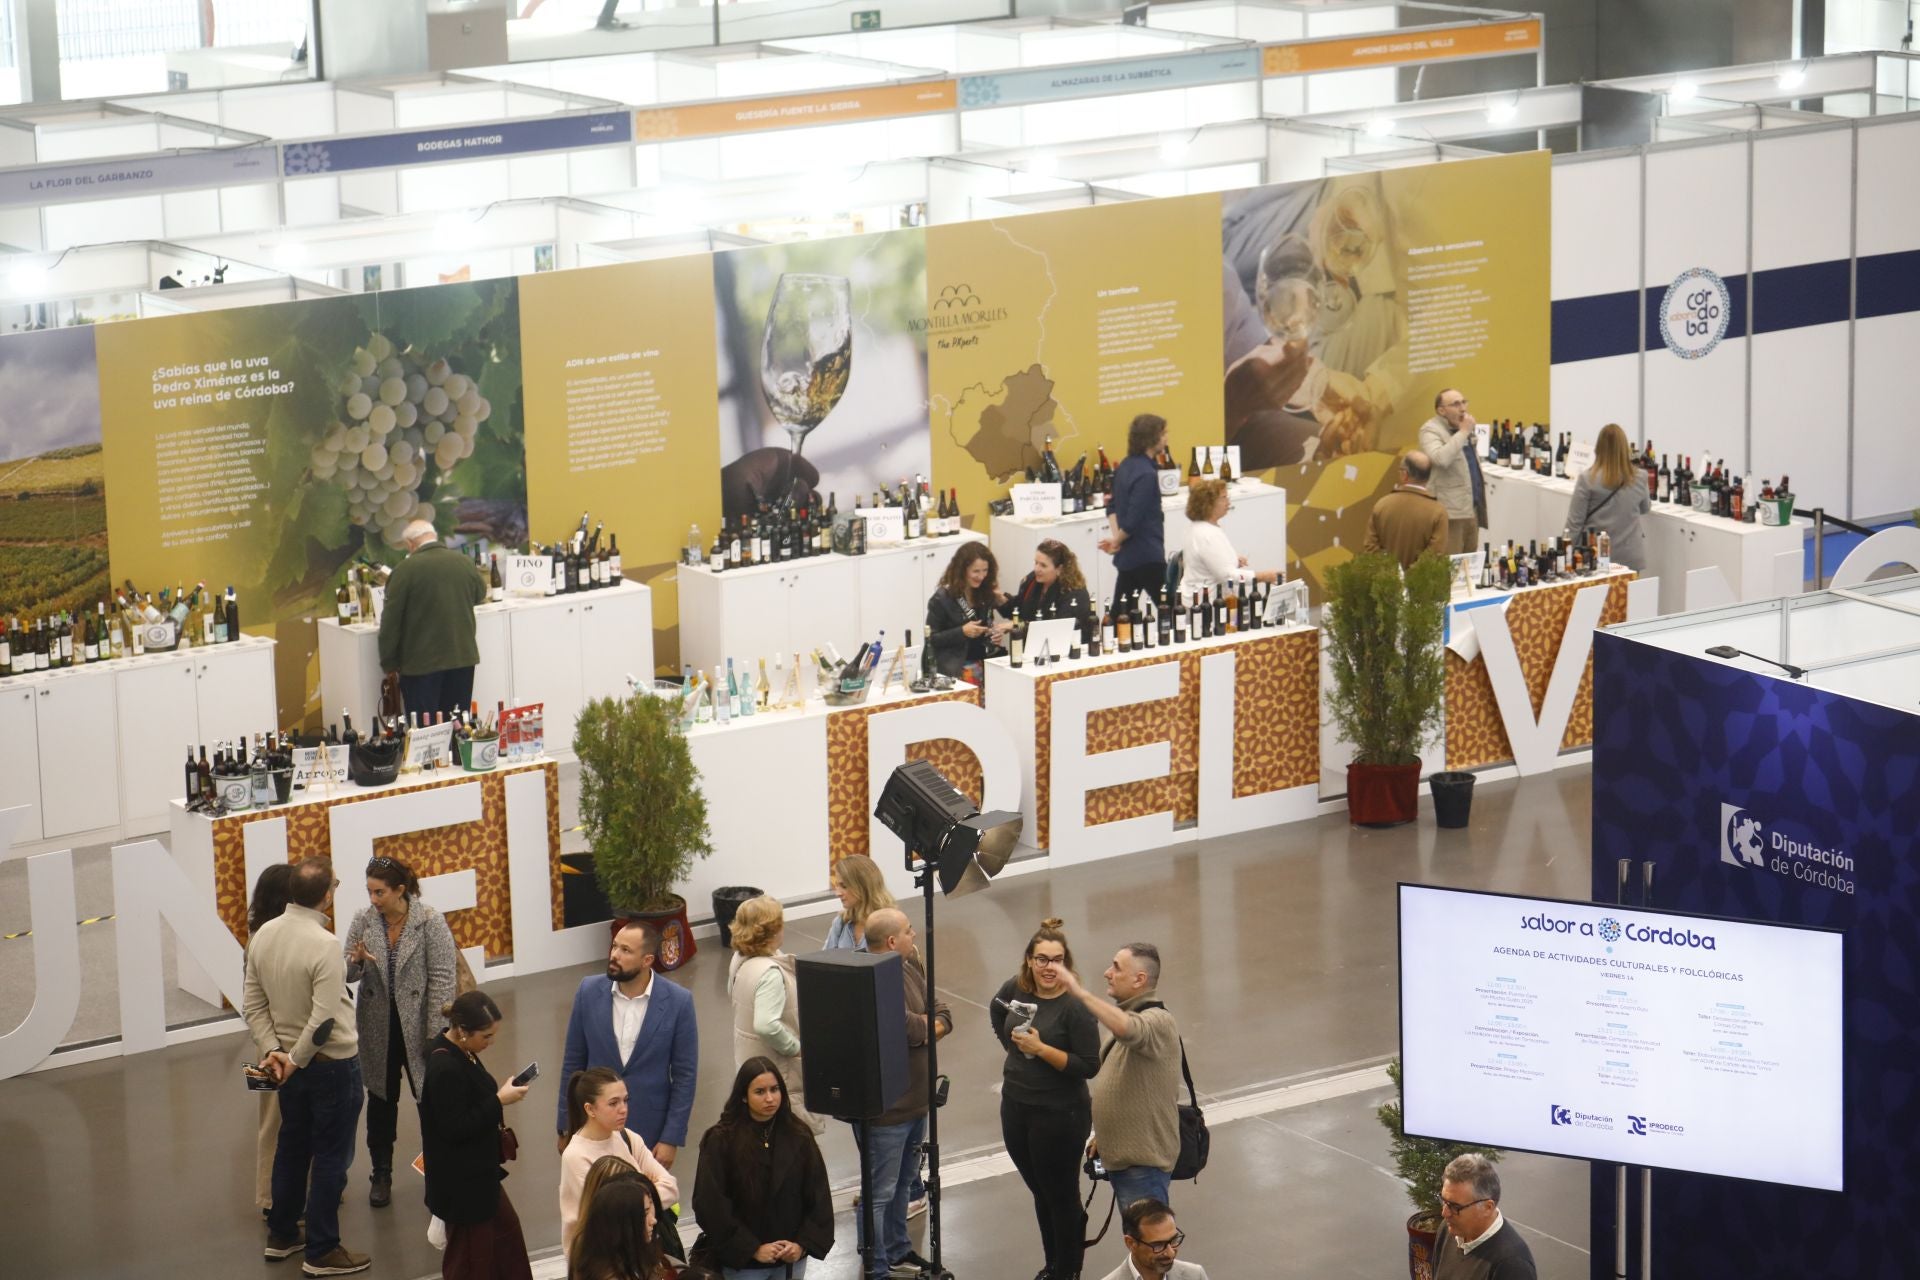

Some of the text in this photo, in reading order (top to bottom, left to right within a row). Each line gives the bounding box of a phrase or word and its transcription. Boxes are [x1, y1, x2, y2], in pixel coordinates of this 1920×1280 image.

[1414, 42, 1427, 50] DEL
[1051, 68, 1171, 88] ALMAZARAS DE LA SUBBÉTICA
[780, 105, 812, 116] FUENTE
[815, 104, 827, 113] LA
[830, 101, 860, 112] SIERRA
[417, 135, 502, 152] BODEGAS HATHOR
[30, 170, 154, 190] LA FLOR DEL GARBANZO
[907, 314, 959, 332] MONTILLA
[938, 339, 949, 349] the
[152, 356, 268, 381] ¿Sabías que la uva
[566, 359, 583, 367] ADN
[608, 353, 629, 362] estilo
[153, 369, 280, 394] Pedro Ximénez es la
[153, 381, 294, 409] uva reina de Córdoba?
[516, 558, 542, 569] FINO
[296, 768, 345, 780] Arrope
[868, 650, 1318, 893] DEL
[1772, 832, 1854, 871] Diputación
[1771, 856, 1854, 894] de Córdoba
[1521, 914, 1576, 933] sabor
[1580, 922, 1593, 936] a
[1493, 946, 1743, 982] AGENDA DE ACTIVIDADES CULTURALES Y FOLCLÓRICAS
[1575, 1112, 1612, 1122] Diputación
[1585, 1121, 1613, 1130] Córdoba
[1649, 1123, 1683, 1132] IPRODECO
